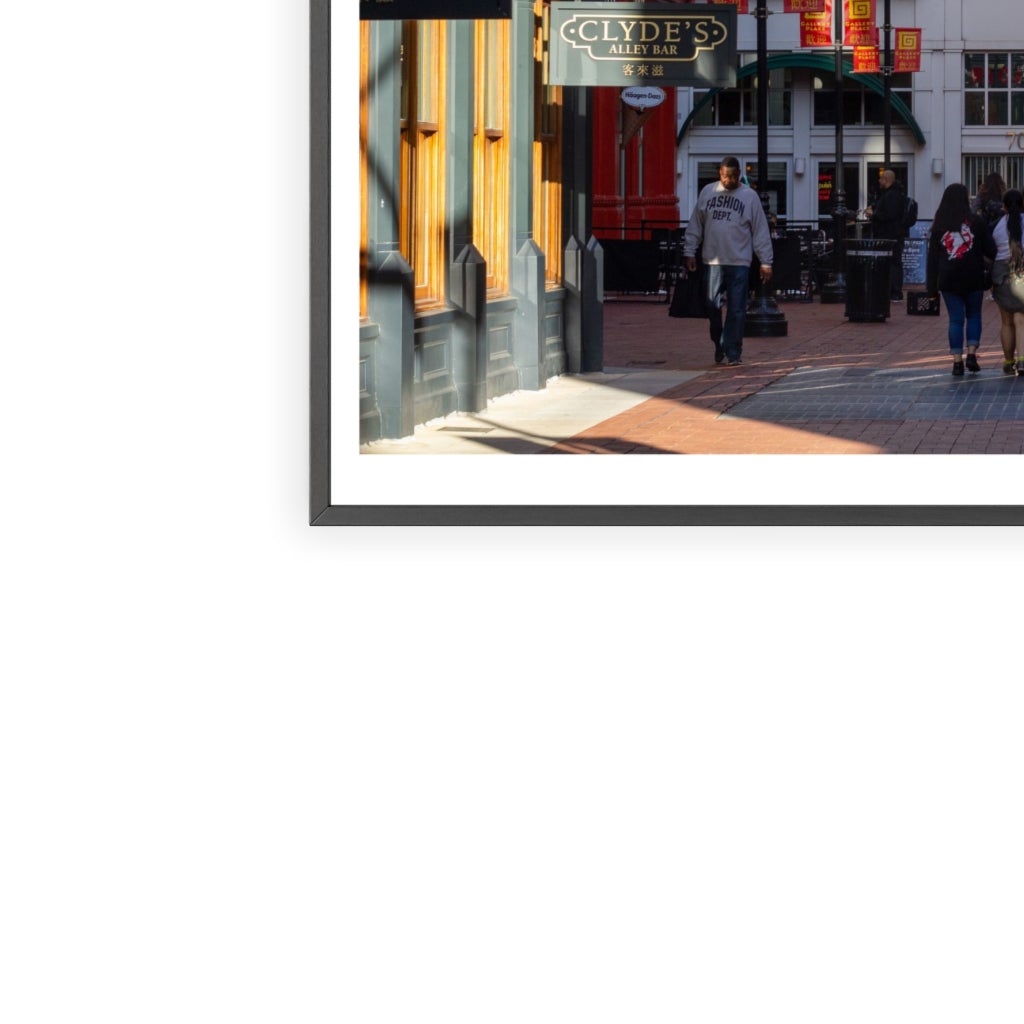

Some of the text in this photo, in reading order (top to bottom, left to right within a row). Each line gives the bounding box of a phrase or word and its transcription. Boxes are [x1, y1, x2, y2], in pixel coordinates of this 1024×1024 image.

[608, 44, 678, 55] ALLEY BAR
[706, 196, 746, 216] FASHION
